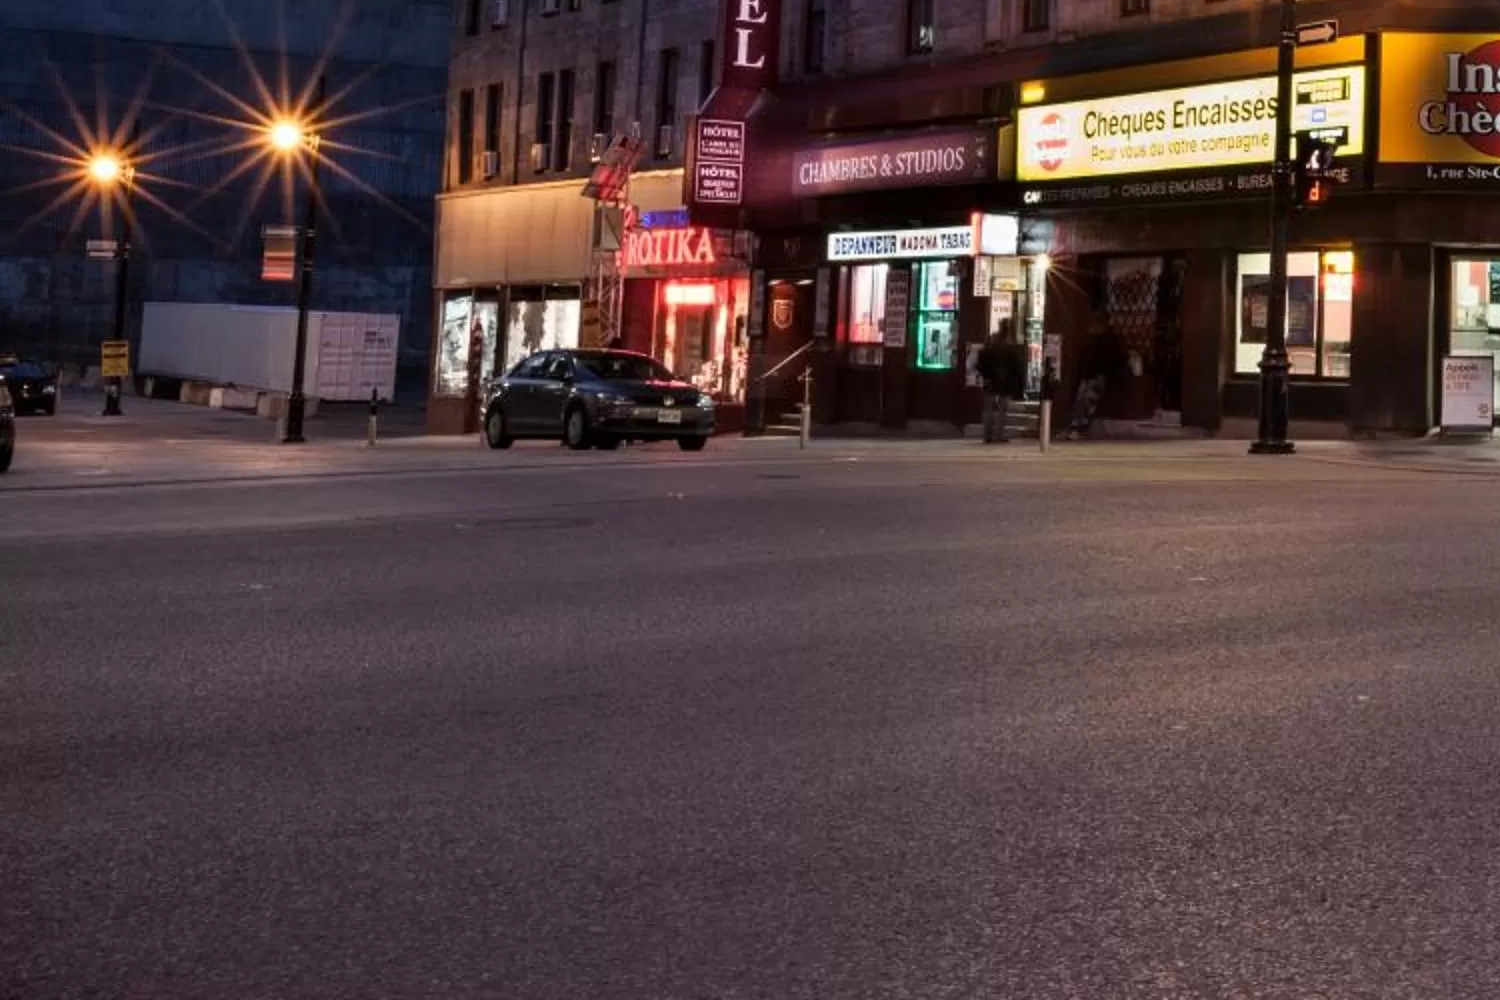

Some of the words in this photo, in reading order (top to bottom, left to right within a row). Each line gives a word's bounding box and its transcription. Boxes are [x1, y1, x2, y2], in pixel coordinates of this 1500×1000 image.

[700, 166, 738, 179] HÔTEL
[799, 155, 877, 185] CHAMBRES
[879, 153, 894, 178] &
[895, 147, 965, 176] STUDIOS
[1237, 173, 1274, 190] BUREA
